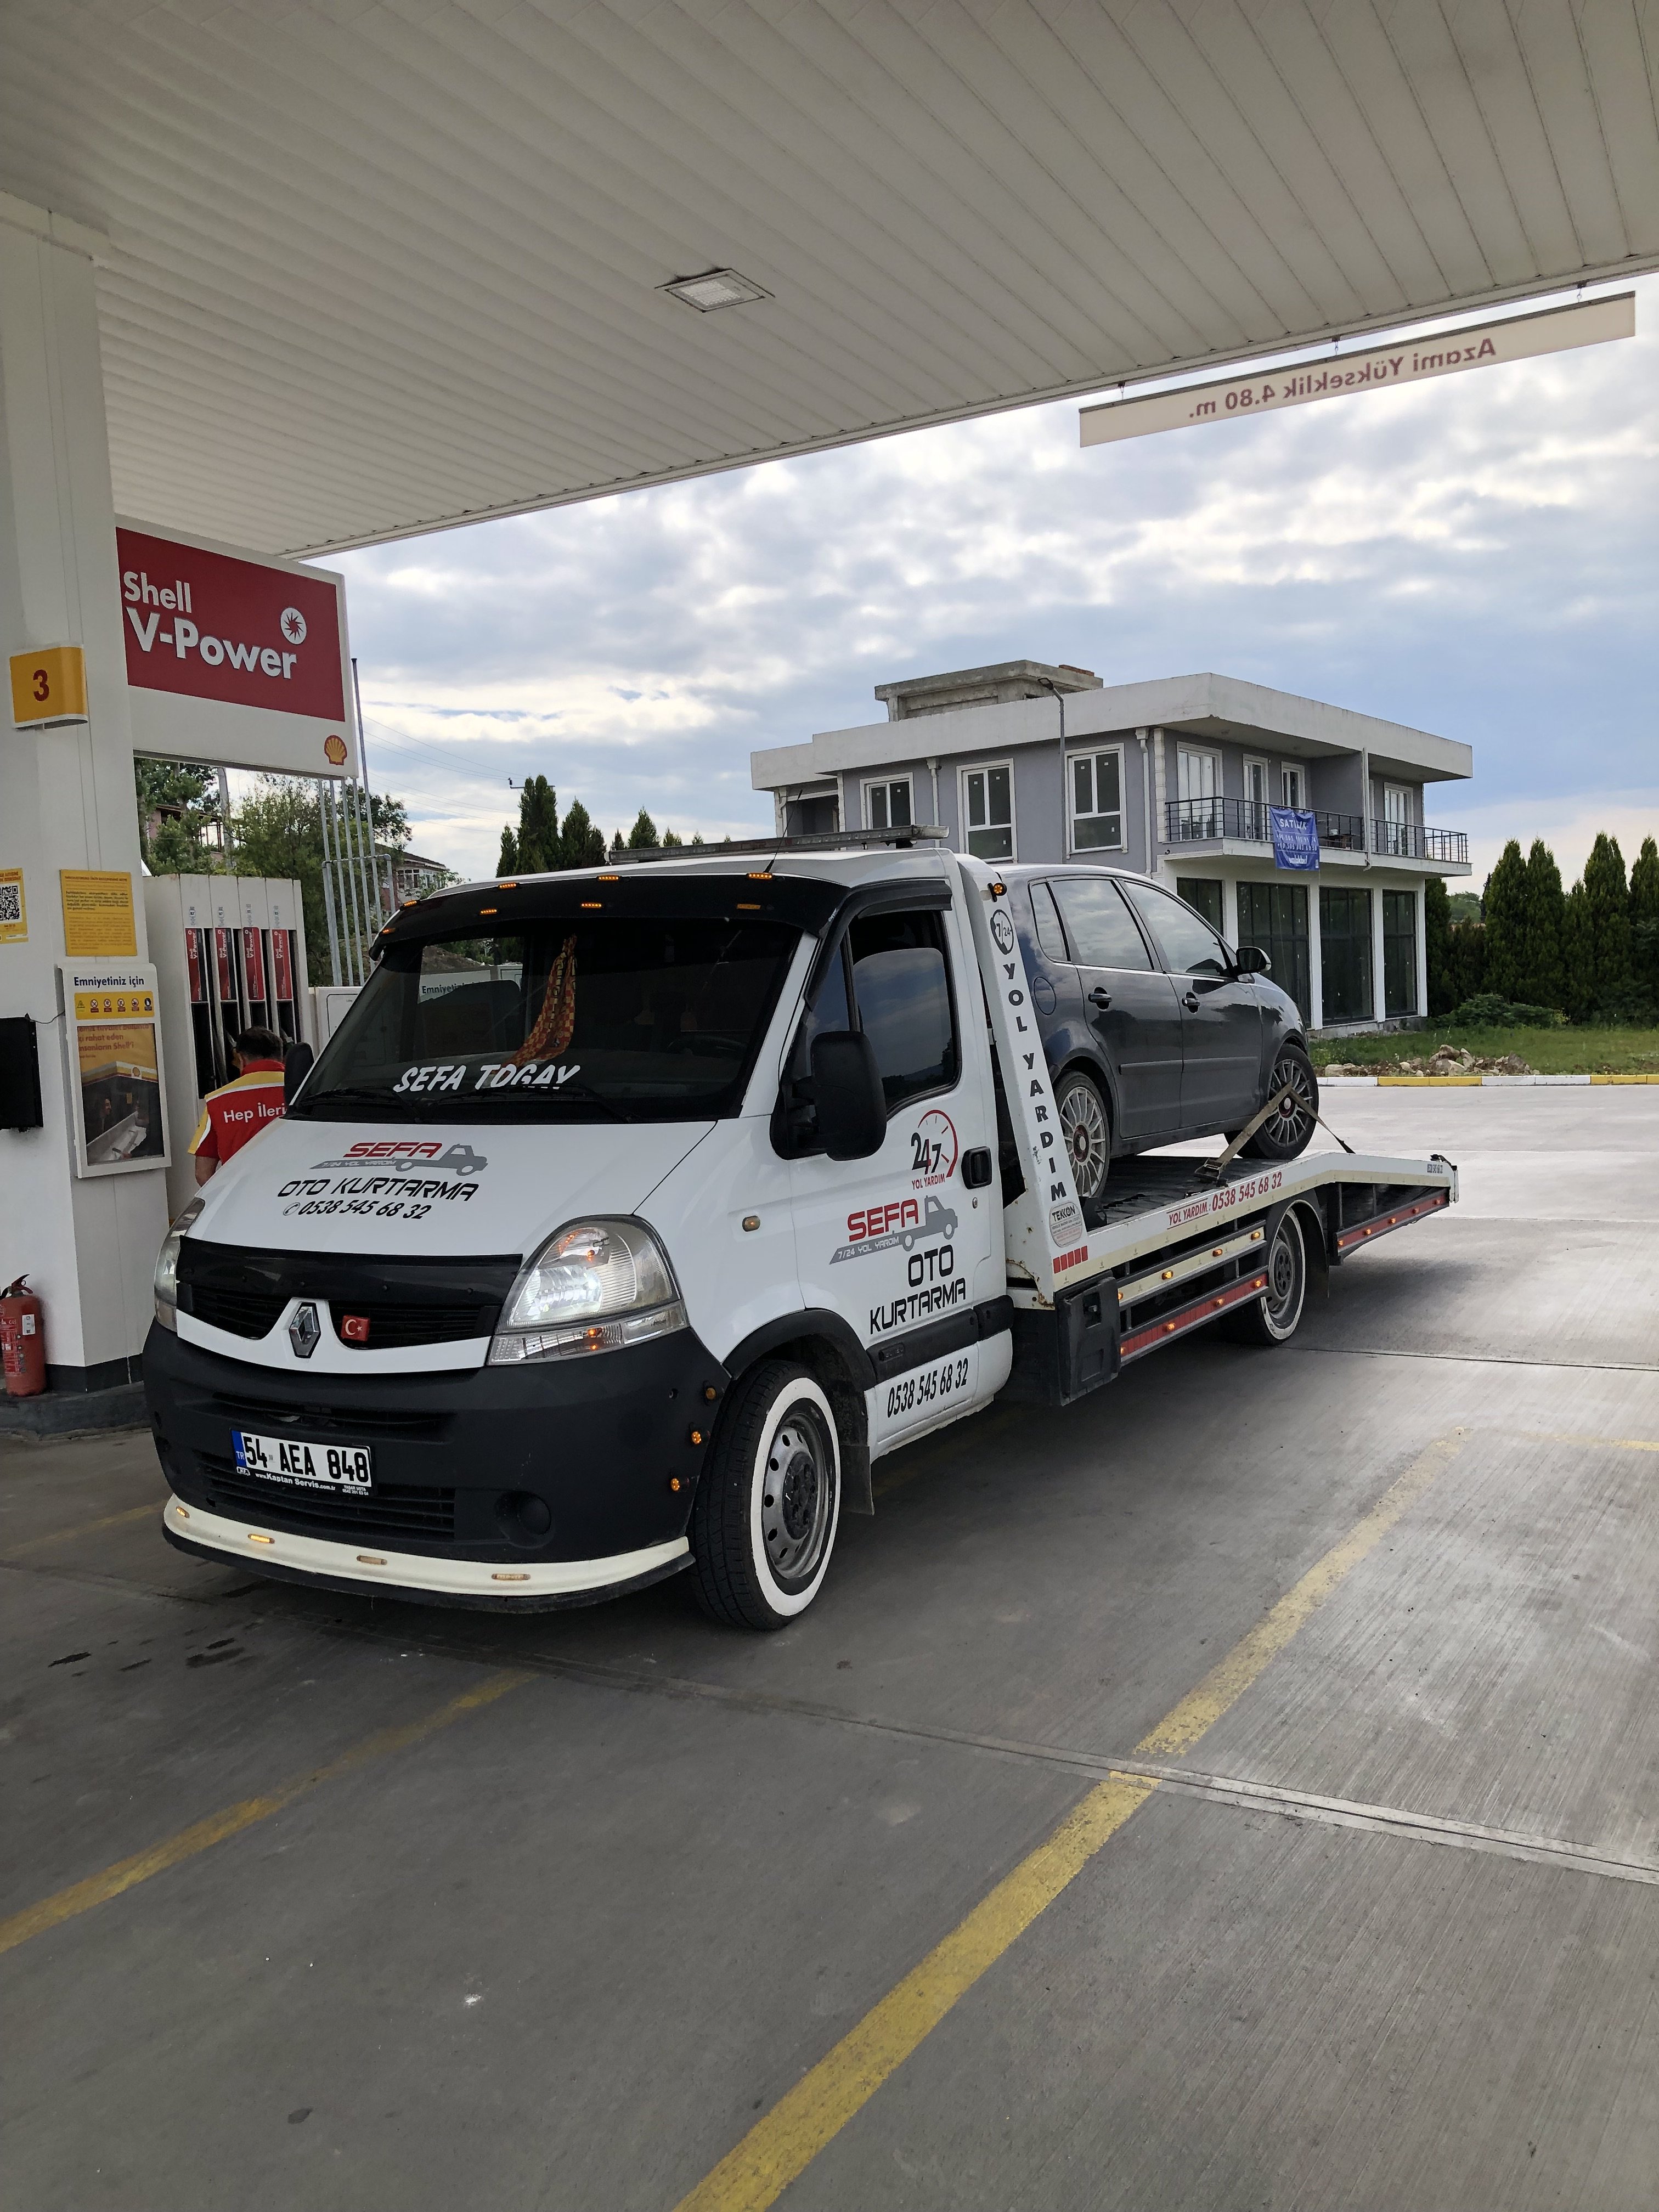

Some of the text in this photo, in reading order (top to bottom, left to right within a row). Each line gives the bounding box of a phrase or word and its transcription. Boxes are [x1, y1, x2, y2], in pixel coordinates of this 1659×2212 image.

[123, 571, 191, 613] Shell
[126, 607, 297, 679] V-Power
[33, 669, 49, 702] 3
[1279, 818, 1307, 830] SATILIK
[74, 975, 144, 988] Emniyetiniz için
[86, 1034, 104, 1042] rahat
[393, 1065, 466, 1092] SEFA
[1003, 963, 1028, 1032] YOL
[1023, 1052, 1067, 1202] YARDIM
[223, 1109, 253, 1123] Hep
[342, 1142, 443, 1158] SEFA
[278, 1177, 479, 1201] OTO KURTARMA
[912, 1173, 945, 1190] YOL YARDIM
[298, 1199, 432, 1220] 0538 545 68 32
[1169, 1211, 1182, 1226] YOL
[1212, 1188, 1235, 1211] 0538
[1238, 1181, 1255, 1203] 545
[1258, 1176, 1269, 1194] 68
[1271, 1171, 1282, 1189] 32
[847, 1198, 919, 1243] SEFA
[838, 1236, 900, 1260] 7/24 YOL YARDIM
[908, 1244, 953, 1288] OTO
[870, 1277, 966, 1335] KURTARMA
[887, 1357, 969, 1418] 0538 545 68 32
[236, 1451, 245, 1460] TR
[242, 1436, 369, 1483] 54 AEA 848
